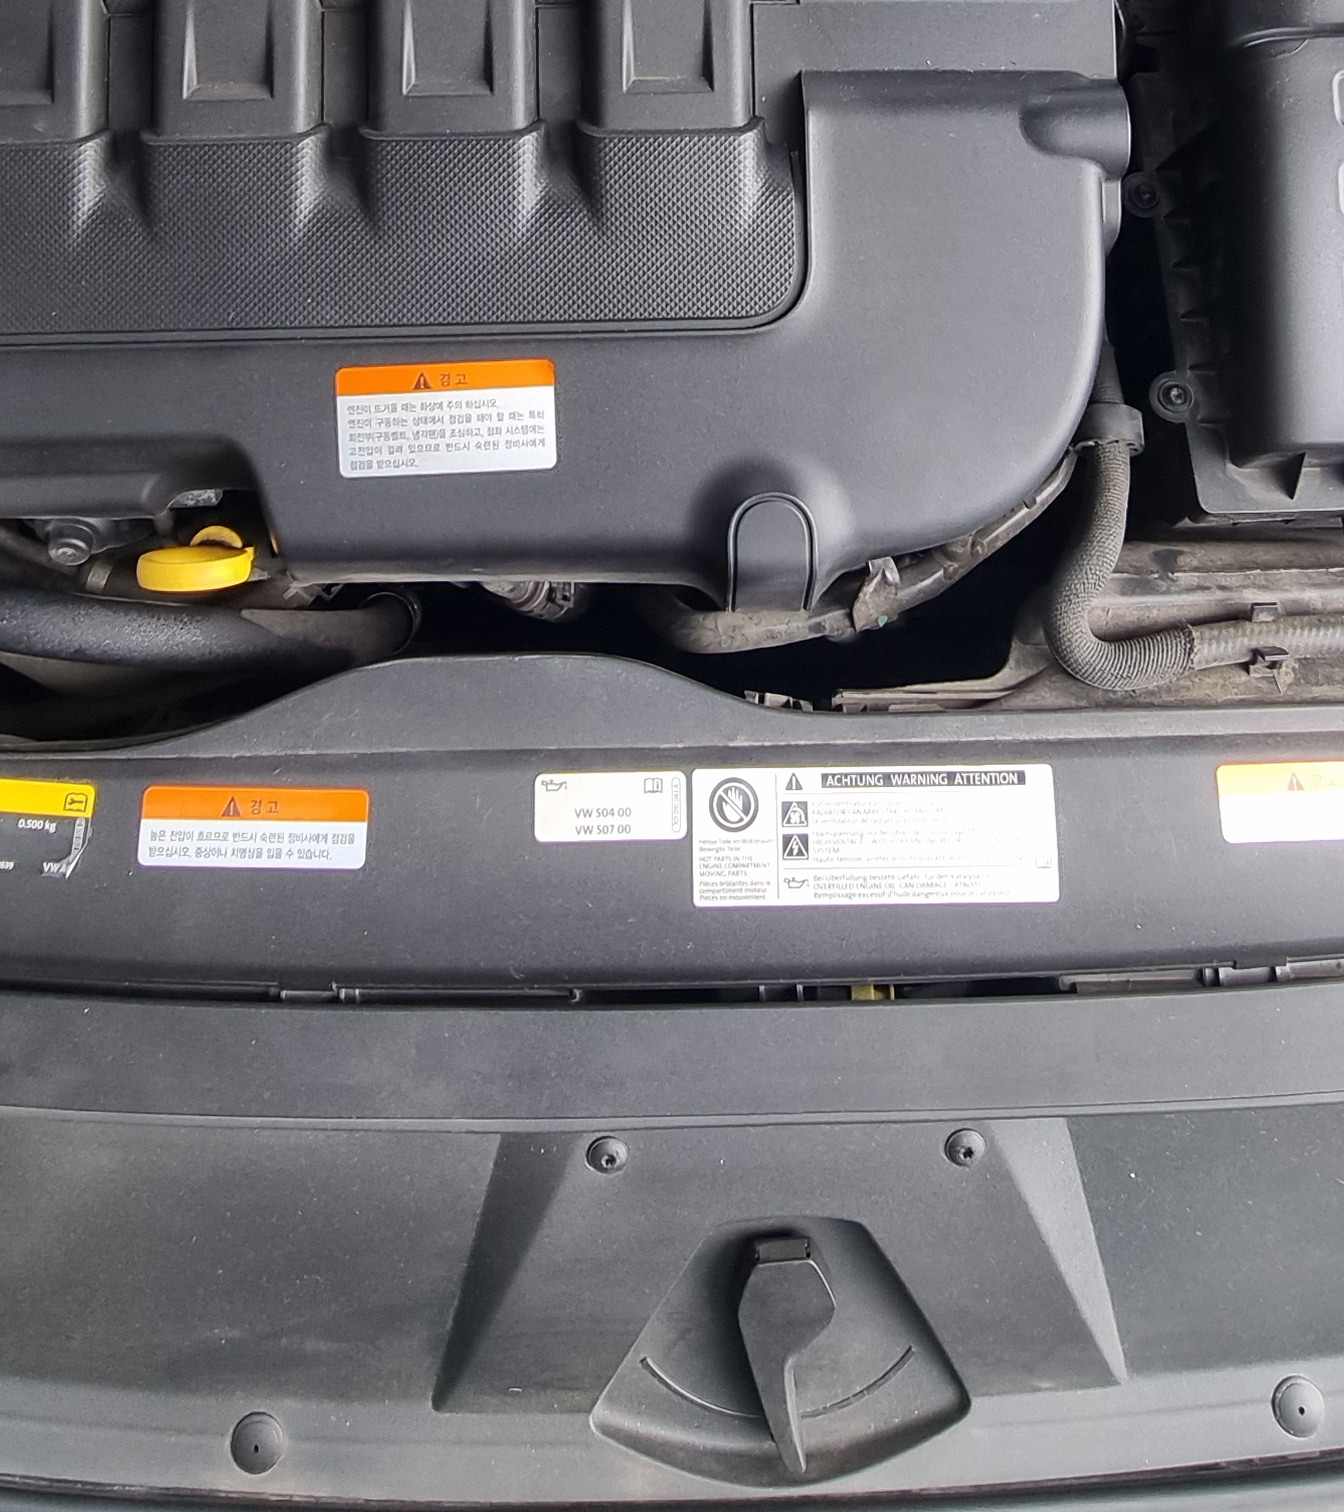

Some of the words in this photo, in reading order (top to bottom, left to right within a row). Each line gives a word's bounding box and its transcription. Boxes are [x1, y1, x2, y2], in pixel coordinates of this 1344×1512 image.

[825, 774, 884, 787] ACHTUNG
[890, 773, 948, 786] WARNING
[954, 772, 1018, 785] ATTENTION
[574, 808, 593, 818] VW
[596, 808, 615, 818] 504
[617, 807, 632, 818] 00
[18, 818, 44, 830] 0.500
[45, 820, 57, 833] kg
[575, 825, 594, 835] VW
[596, 825, 615, 835] 507
[617, 824, 632, 834] 00
